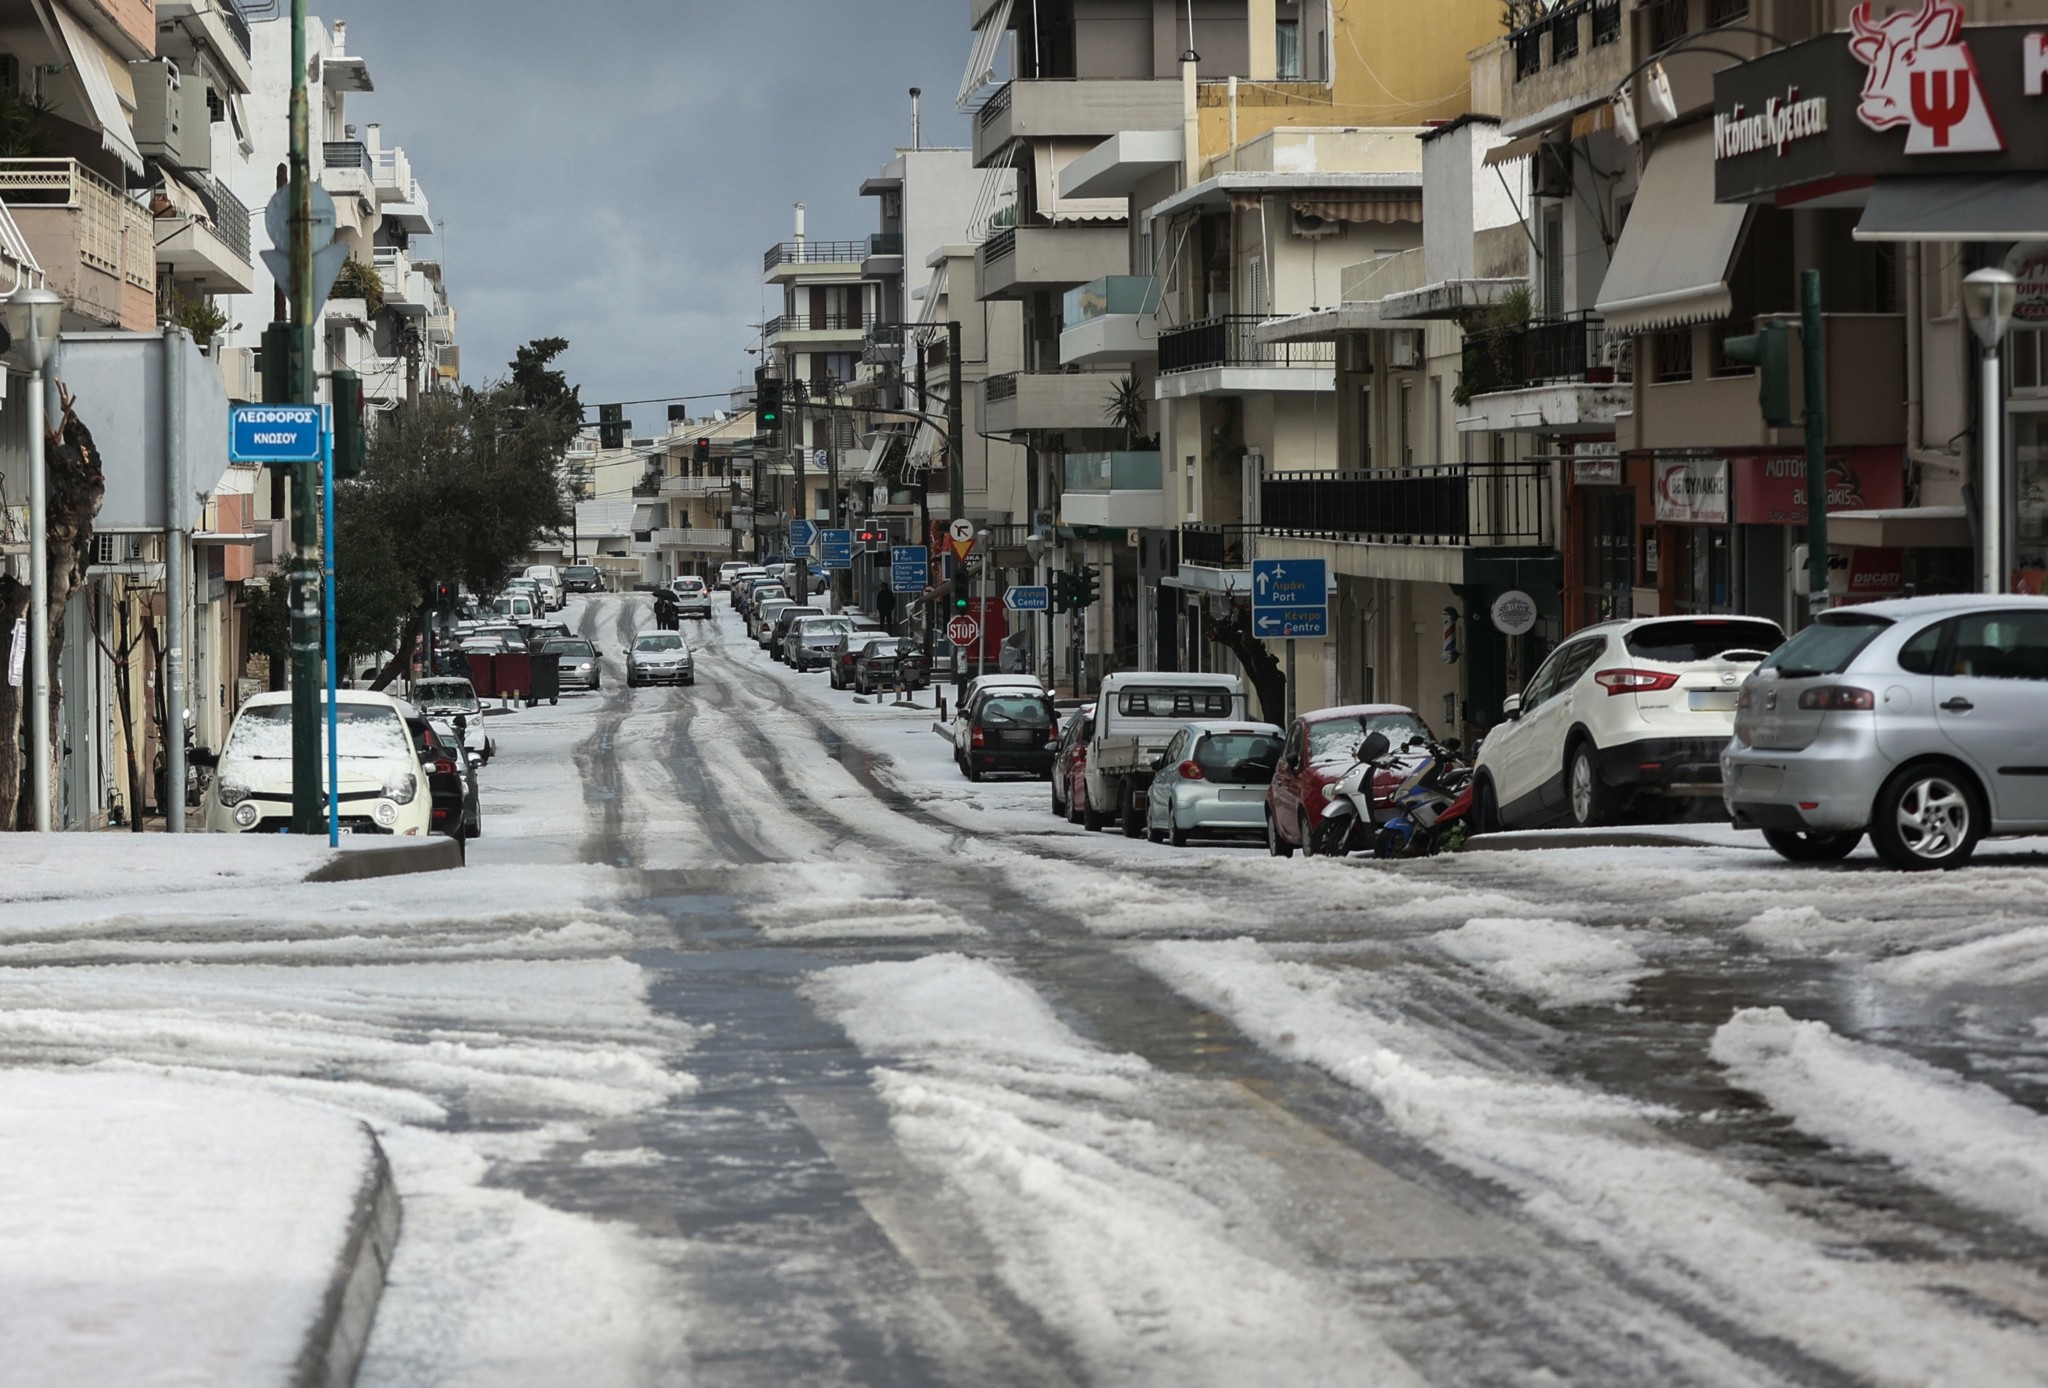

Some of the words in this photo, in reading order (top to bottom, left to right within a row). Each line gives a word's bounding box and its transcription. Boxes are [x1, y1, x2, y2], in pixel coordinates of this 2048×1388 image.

[1714, 102, 1764, 160] Ντόπια
[1766, 85, 1826, 157] Κρέατα
[238, 411, 313, 424] ΛΕΩΦΟΡΟΣ
[253, 432, 298, 445] ΚΝΩΣΟΥ
[1853, 572, 1900, 583] DUCATI
[1272, 580, 1305, 591] Λιμάνι
[1017, 588, 1045, 598] Κέντρο
[1273, 592, 1295, 601] Port
[1284, 611, 1321, 621] Κέντρο
[950, 623, 976, 639] STOP
[1284, 622, 1321, 632] Centre
